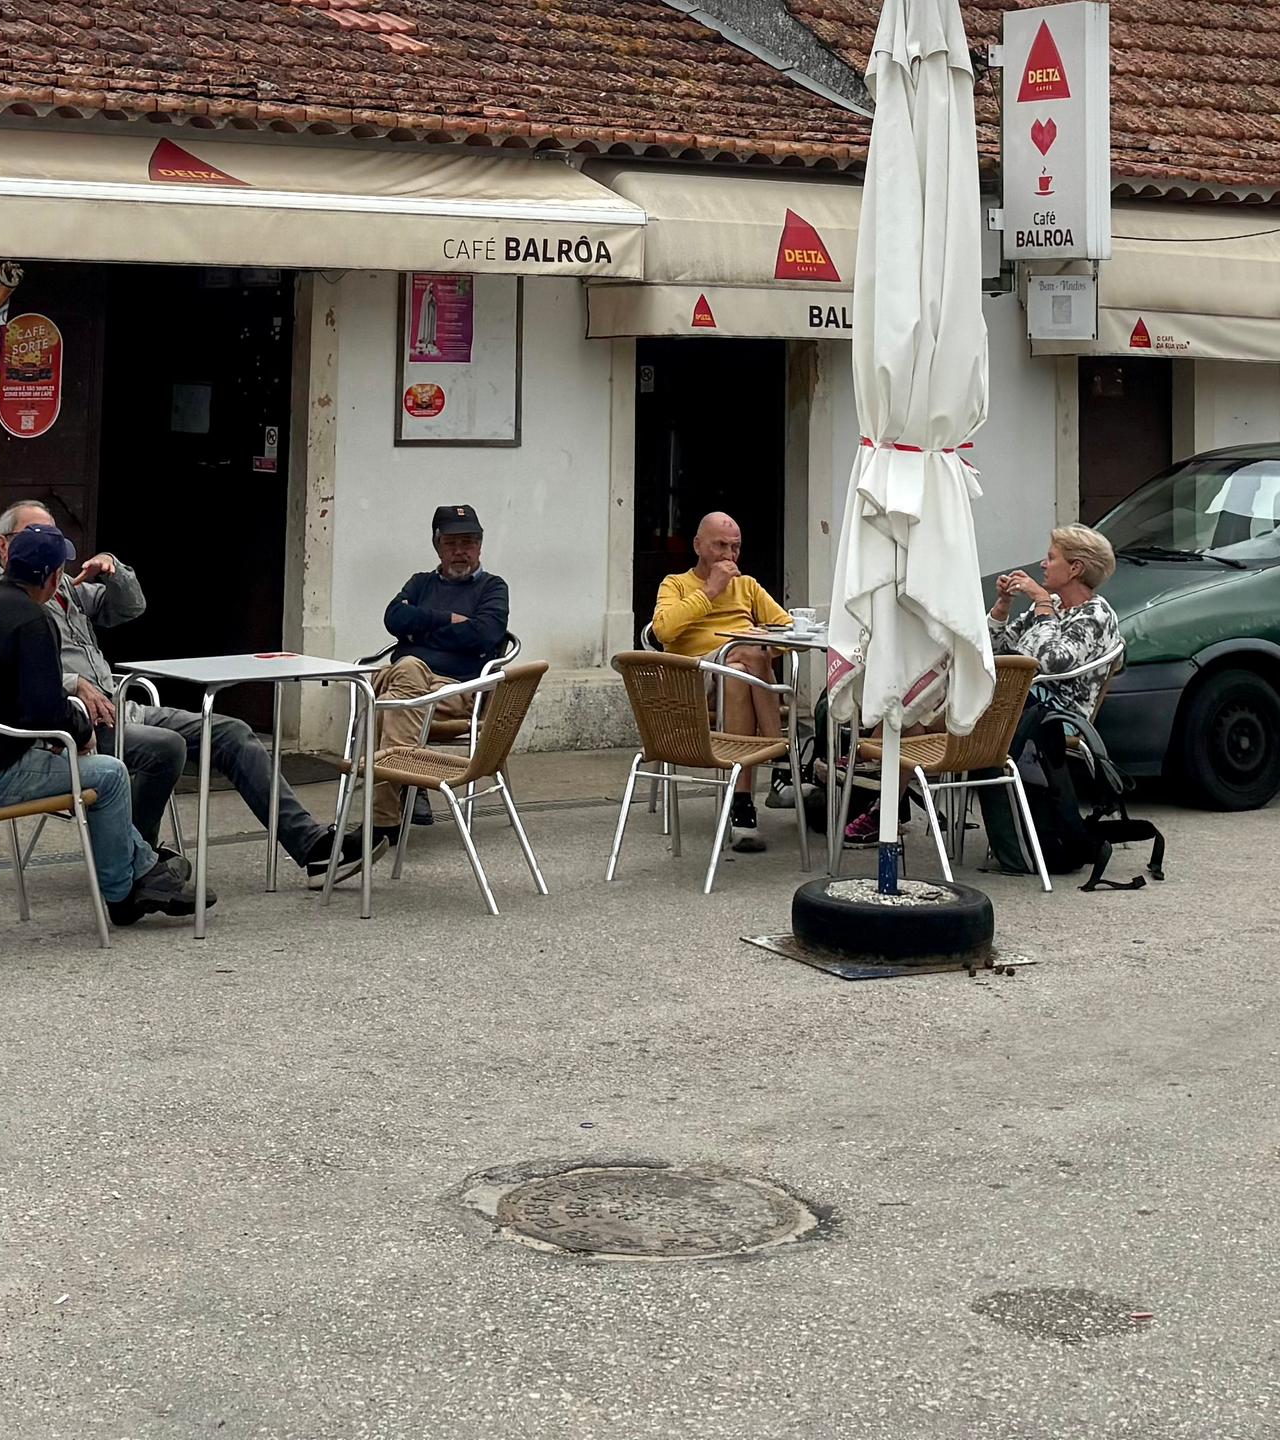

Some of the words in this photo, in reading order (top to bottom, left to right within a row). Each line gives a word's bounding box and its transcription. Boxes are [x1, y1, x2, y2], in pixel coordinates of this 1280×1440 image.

[1028, 68, 1061, 84] DELTA
[157, 168, 225, 180] DELTA
[1033, 210, 1056, 226] Café
[1016, 228, 1074, 248] BALROA
[443, 237, 496, 261] CAFÉ
[504, 235, 612, 264] BALRÔA
[784, 249, 826, 264] DELTA
[808, 305, 853, 329] BAL
[12, 338, 49, 355] SORTE
